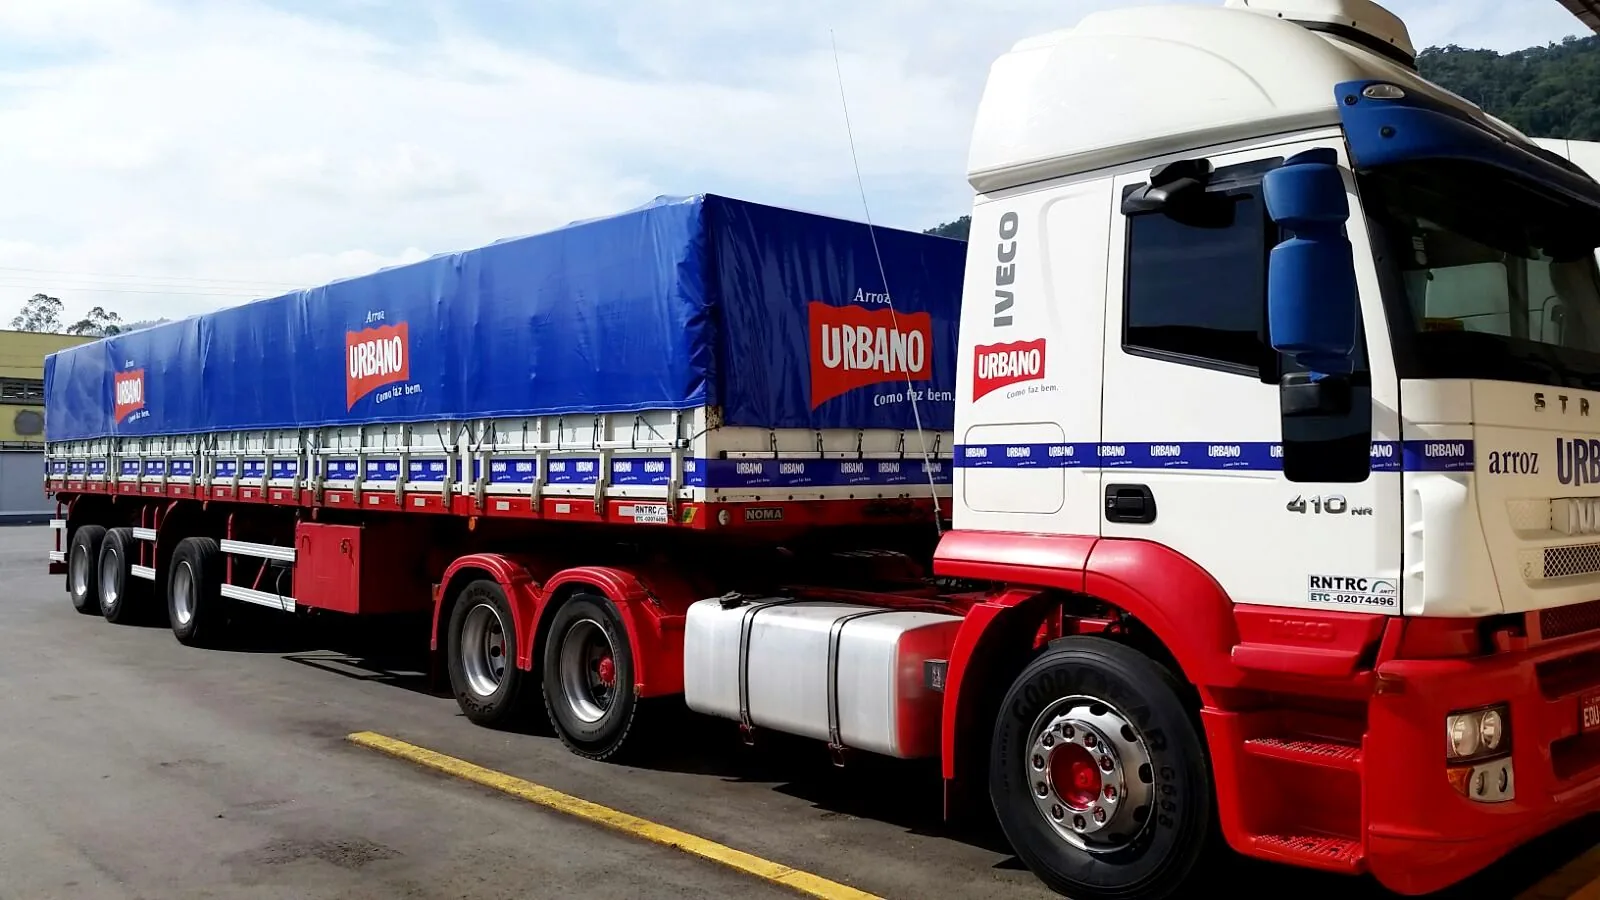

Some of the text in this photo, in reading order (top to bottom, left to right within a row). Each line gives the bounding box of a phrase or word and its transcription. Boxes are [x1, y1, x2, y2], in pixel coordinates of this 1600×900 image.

[993, 211, 1018, 327] IVECO
[854, 288, 891, 304] Arroz
[821, 324, 925, 373] URBANO
[349, 335, 403, 379] URBANO
[978, 348, 1041, 380] URBANO
[873, 394, 903, 407] Como
[1150, 445, 1181, 457] URBANO
[1208, 445, 1241, 458] URBANO
[1425, 443, 1465, 457] URBANO
[736, 462, 763, 474] URBANO
[779, 462, 805, 474] URBANO
[1488, 450, 1539, 475] arroz
[635, 505, 657, 514] RNTRC
[1286, 494, 1373, 516] 410 NR
[746, 510, 782, 520] NOMA
[1310, 575, 1368, 592] RNTRC
[1311, 592, 1331, 602] ETC
